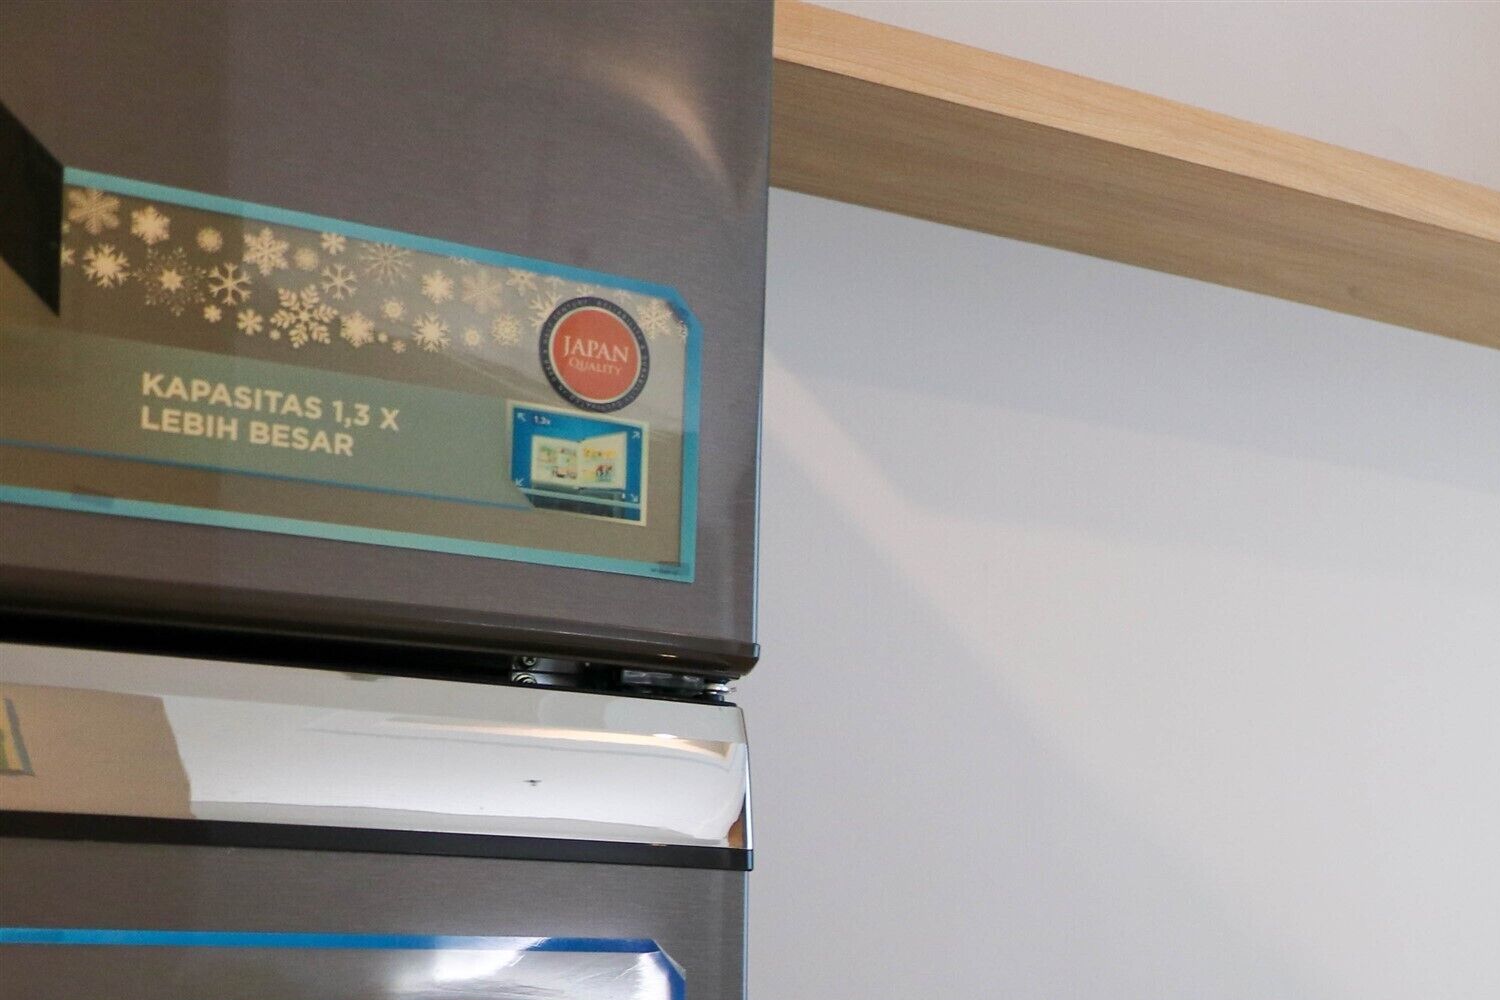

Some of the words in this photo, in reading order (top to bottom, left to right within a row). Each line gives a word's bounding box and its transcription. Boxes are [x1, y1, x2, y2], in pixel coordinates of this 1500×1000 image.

[563, 335, 630, 364] JAPAN
[568, 356, 622, 375] QUALITY
[142, 370, 323, 420] KAPASITAS
[331, 400, 371, 428] 1,3
[379, 406, 400, 432] X
[140, 405, 239, 441] LEBIH
[249, 420, 354, 457] BESAR
